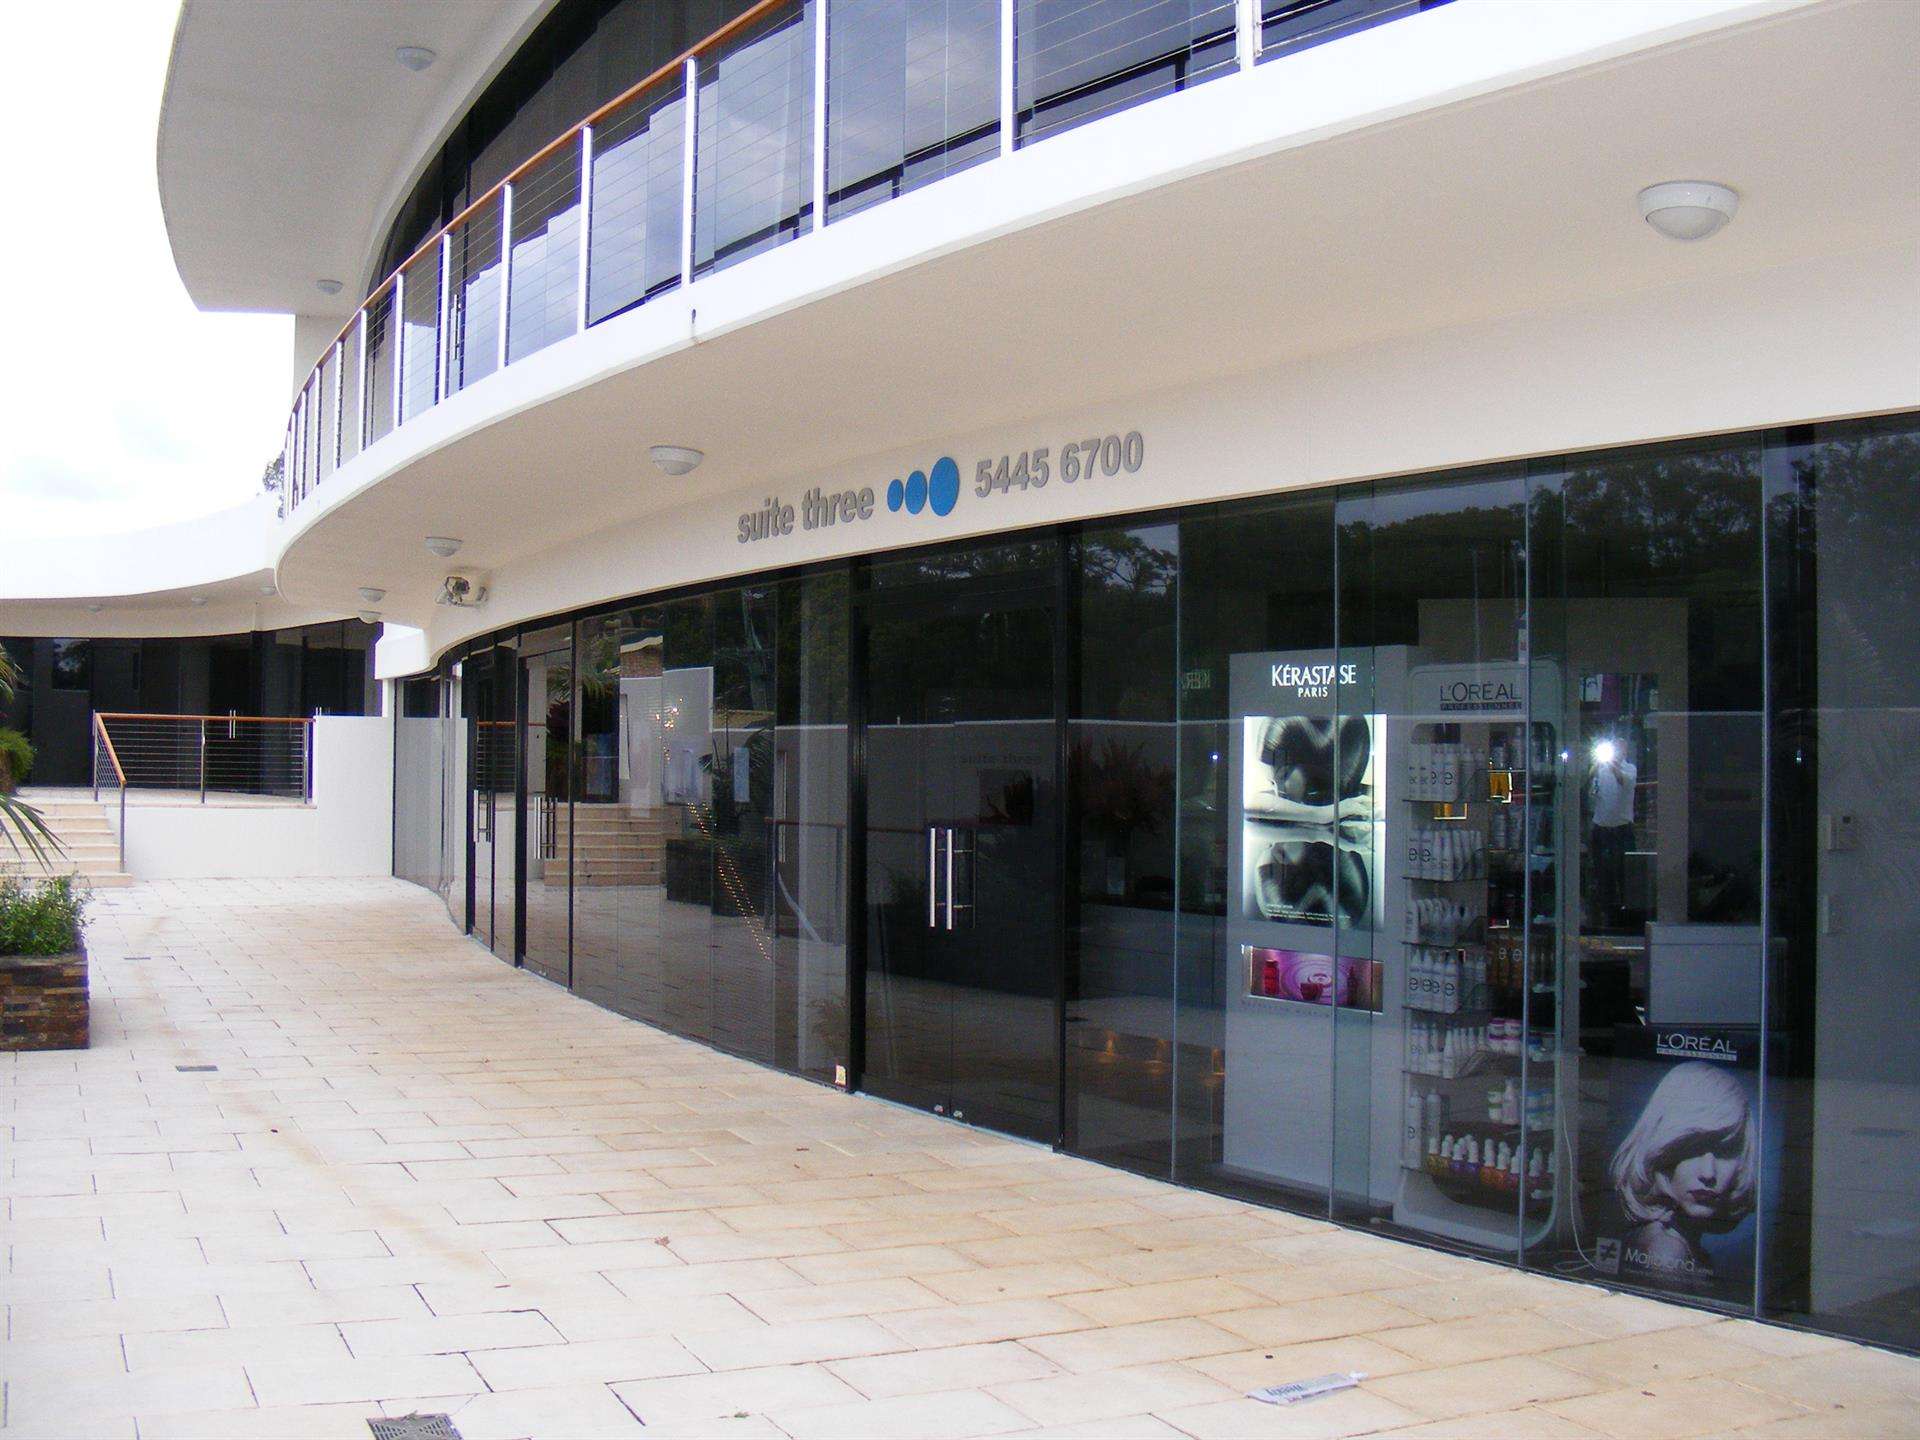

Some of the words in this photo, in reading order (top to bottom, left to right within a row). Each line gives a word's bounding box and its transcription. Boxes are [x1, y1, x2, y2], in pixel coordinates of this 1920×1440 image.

[737, 497, 794, 544] suite
[801, 486, 875, 531] three
[974, 447, 1050, 498] 5445
[1059, 431, 1144, 484] 6700
[1271, 663, 1357, 687] KÉRASTASE
[1297, 686, 1329, 698] PARIS
[1439, 680, 1522, 702] L'ORÉAL
[1656, 1033, 1738, 1055] L'ORÉAL
